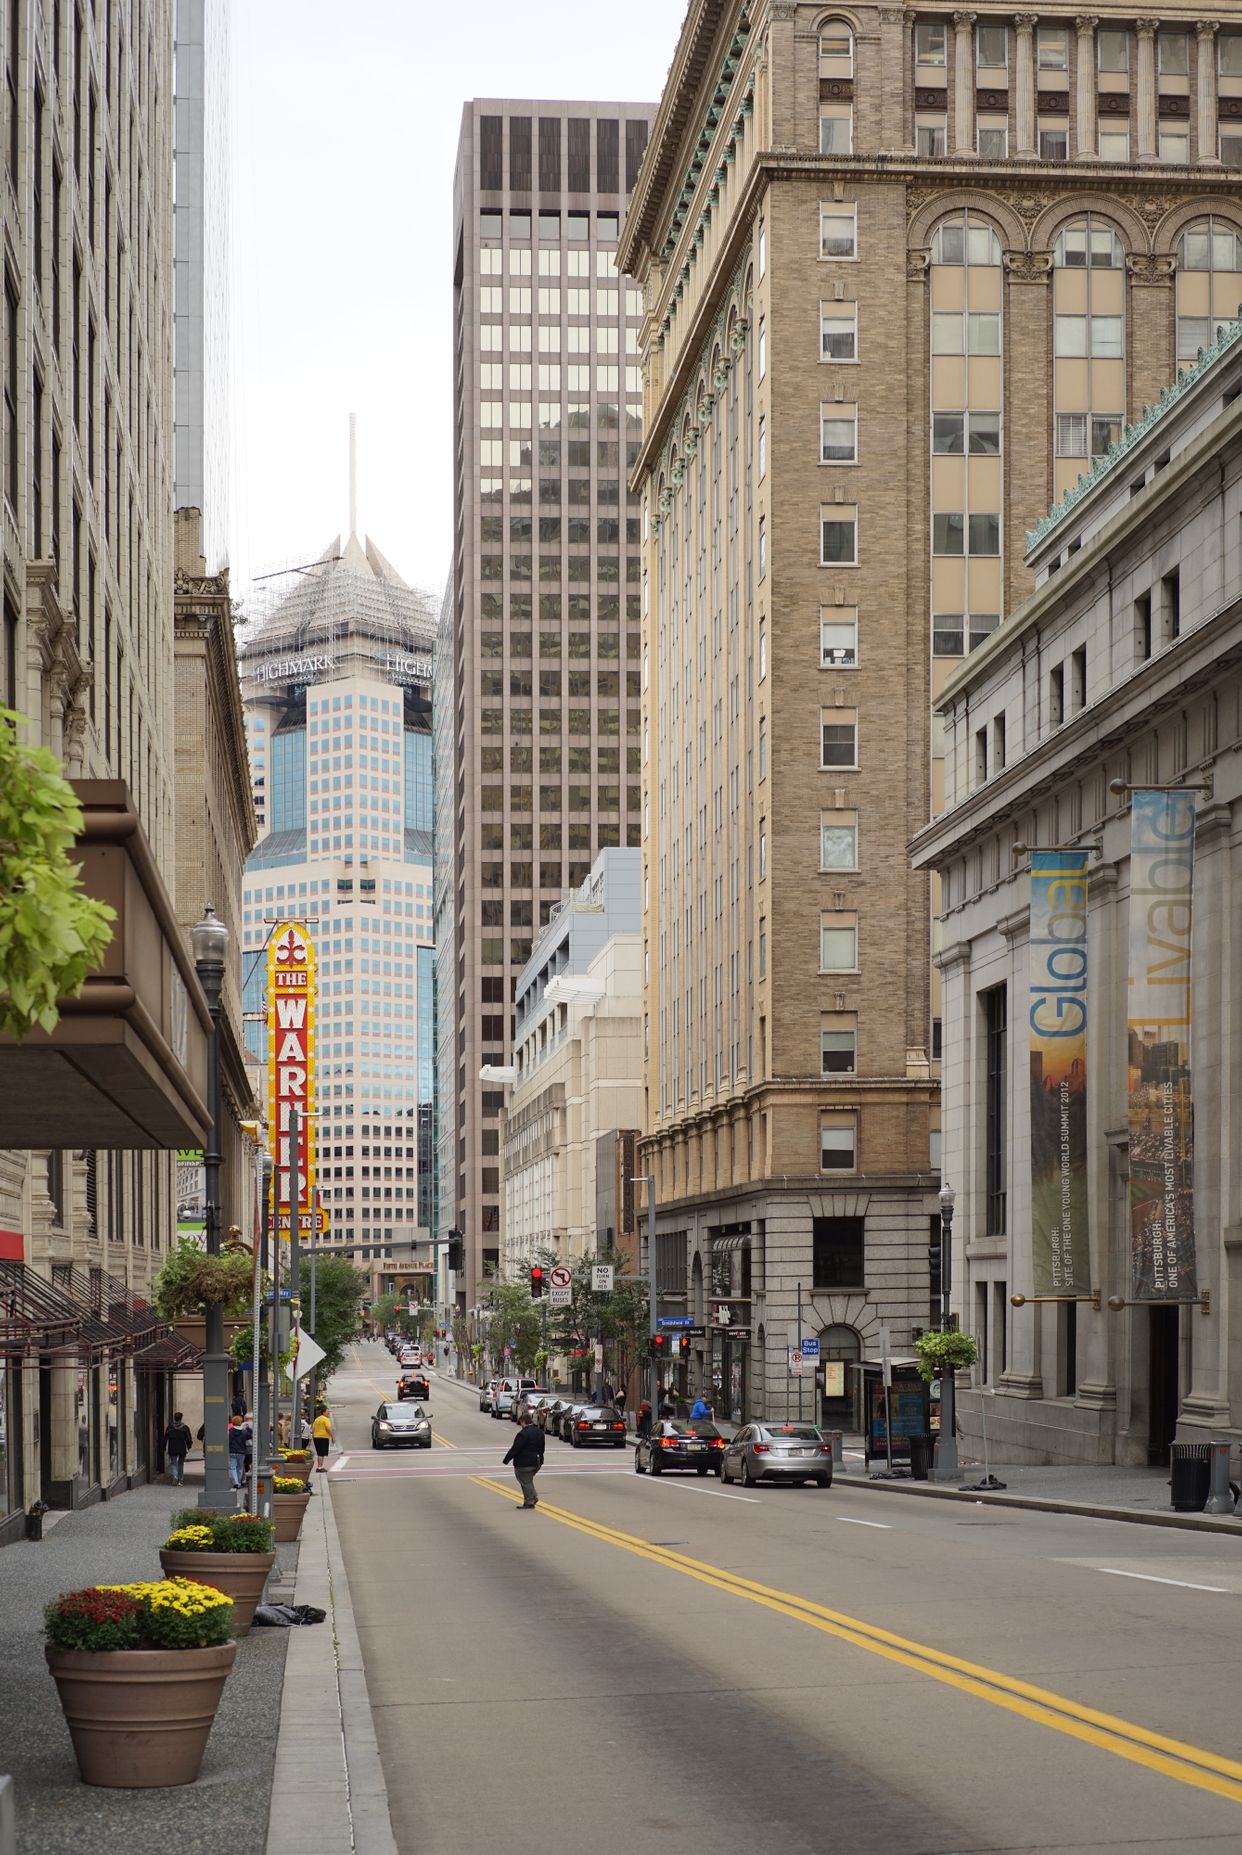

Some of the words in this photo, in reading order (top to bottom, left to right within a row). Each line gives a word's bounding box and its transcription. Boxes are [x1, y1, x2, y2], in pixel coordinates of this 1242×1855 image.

[257, 654, 335, 683] HIGHMARK
[1128, 803, 1196, 1026] Livable
[1029, 861, 1088, 1038] Global
[276, 972, 307, 986] THE
[276, 999, 307, 1202] WARNER
[1060, 1082, 1069, 1103] 2012
[1163, 1081, 1174, 1114] CITIES
[1060, 1105, 1069, 1142] SUMMIT
[1163, 1116, 1174, 1160] LIVABLE
[1060, 1144, 1070, 1177] WORLD
[1164, 1162, 1175, 1191] MOST
[1061, 1179, 1071, 1210] YOUNG
[1062, 1212, 1071, 1231] ONE
[1165, 1193, 1177, 1248] AMERICA'S
[1051, 1226, 1061, 1286] PITTSBURGH:
[1062, 1233, 1072, 1251] THE
[1152, 1220, 1165, 1288] PITTSBURGH:
[1167, 1250, 1177, 1264] OF
[1063, 1252, 1073, 1265] OF
[1064, 1267, 1074, 1287] SITE
[1168, 1266, 1178, 1288] ONE
